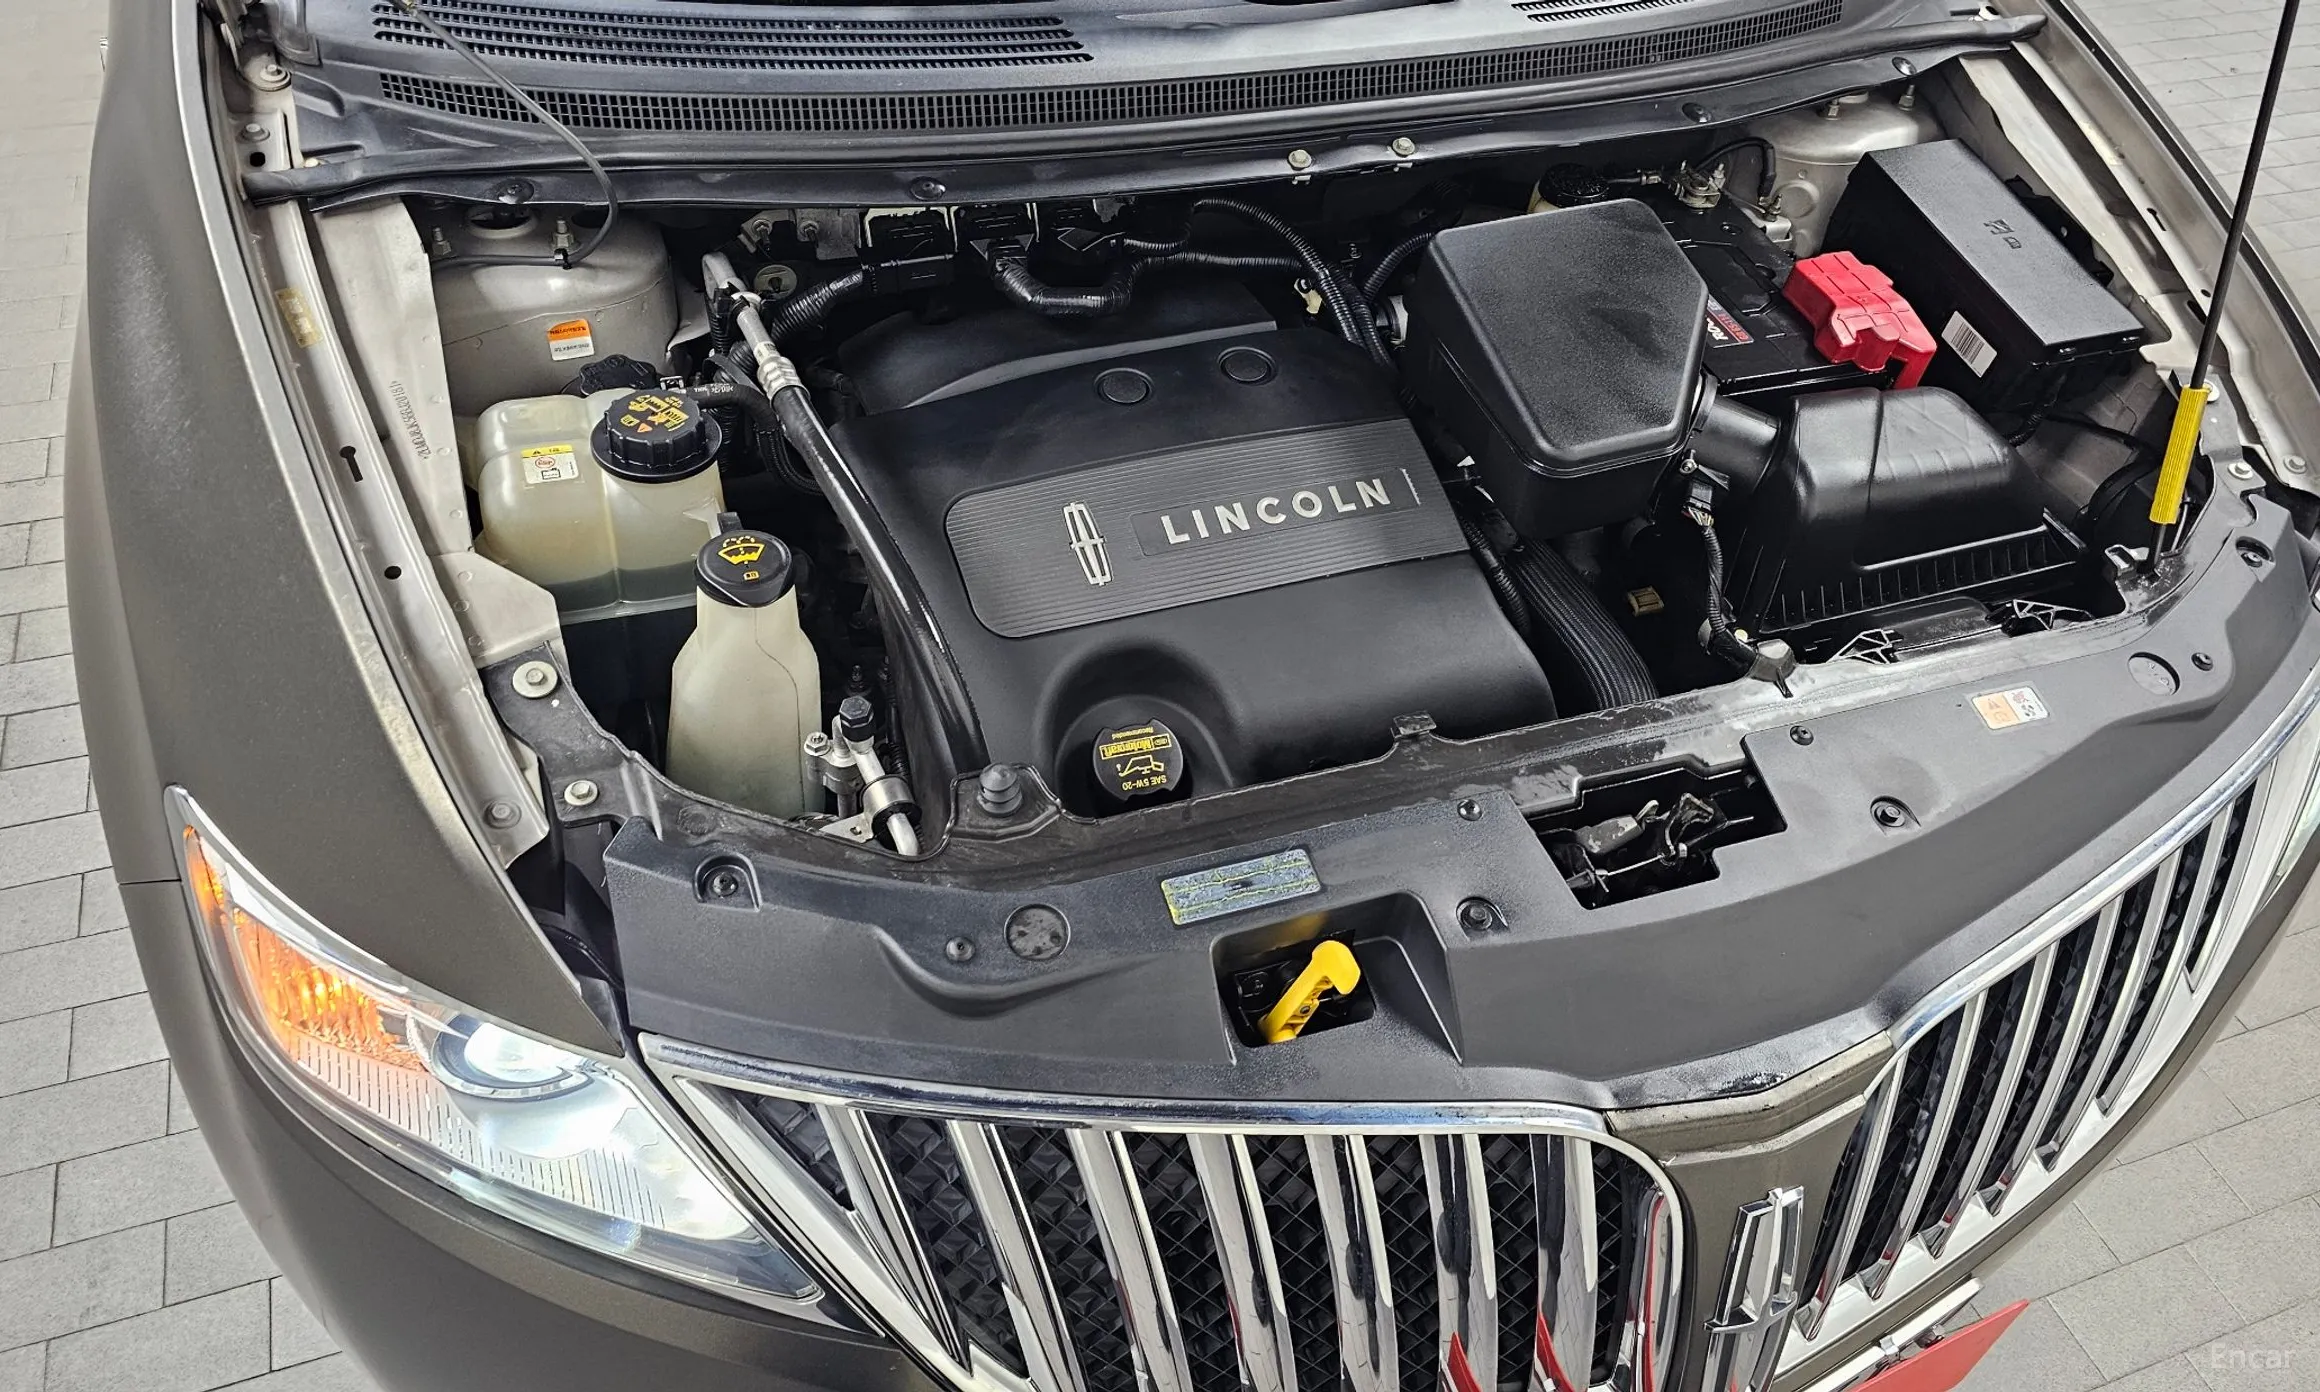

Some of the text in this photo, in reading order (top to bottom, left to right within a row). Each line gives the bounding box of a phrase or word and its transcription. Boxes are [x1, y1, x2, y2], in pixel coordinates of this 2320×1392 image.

[1160, 478, 1391, 545] LINCOLN
[1104, 738, 1152, 757] Motorcraft
[1122, 774, 1167, 791] SAE 5W-20
